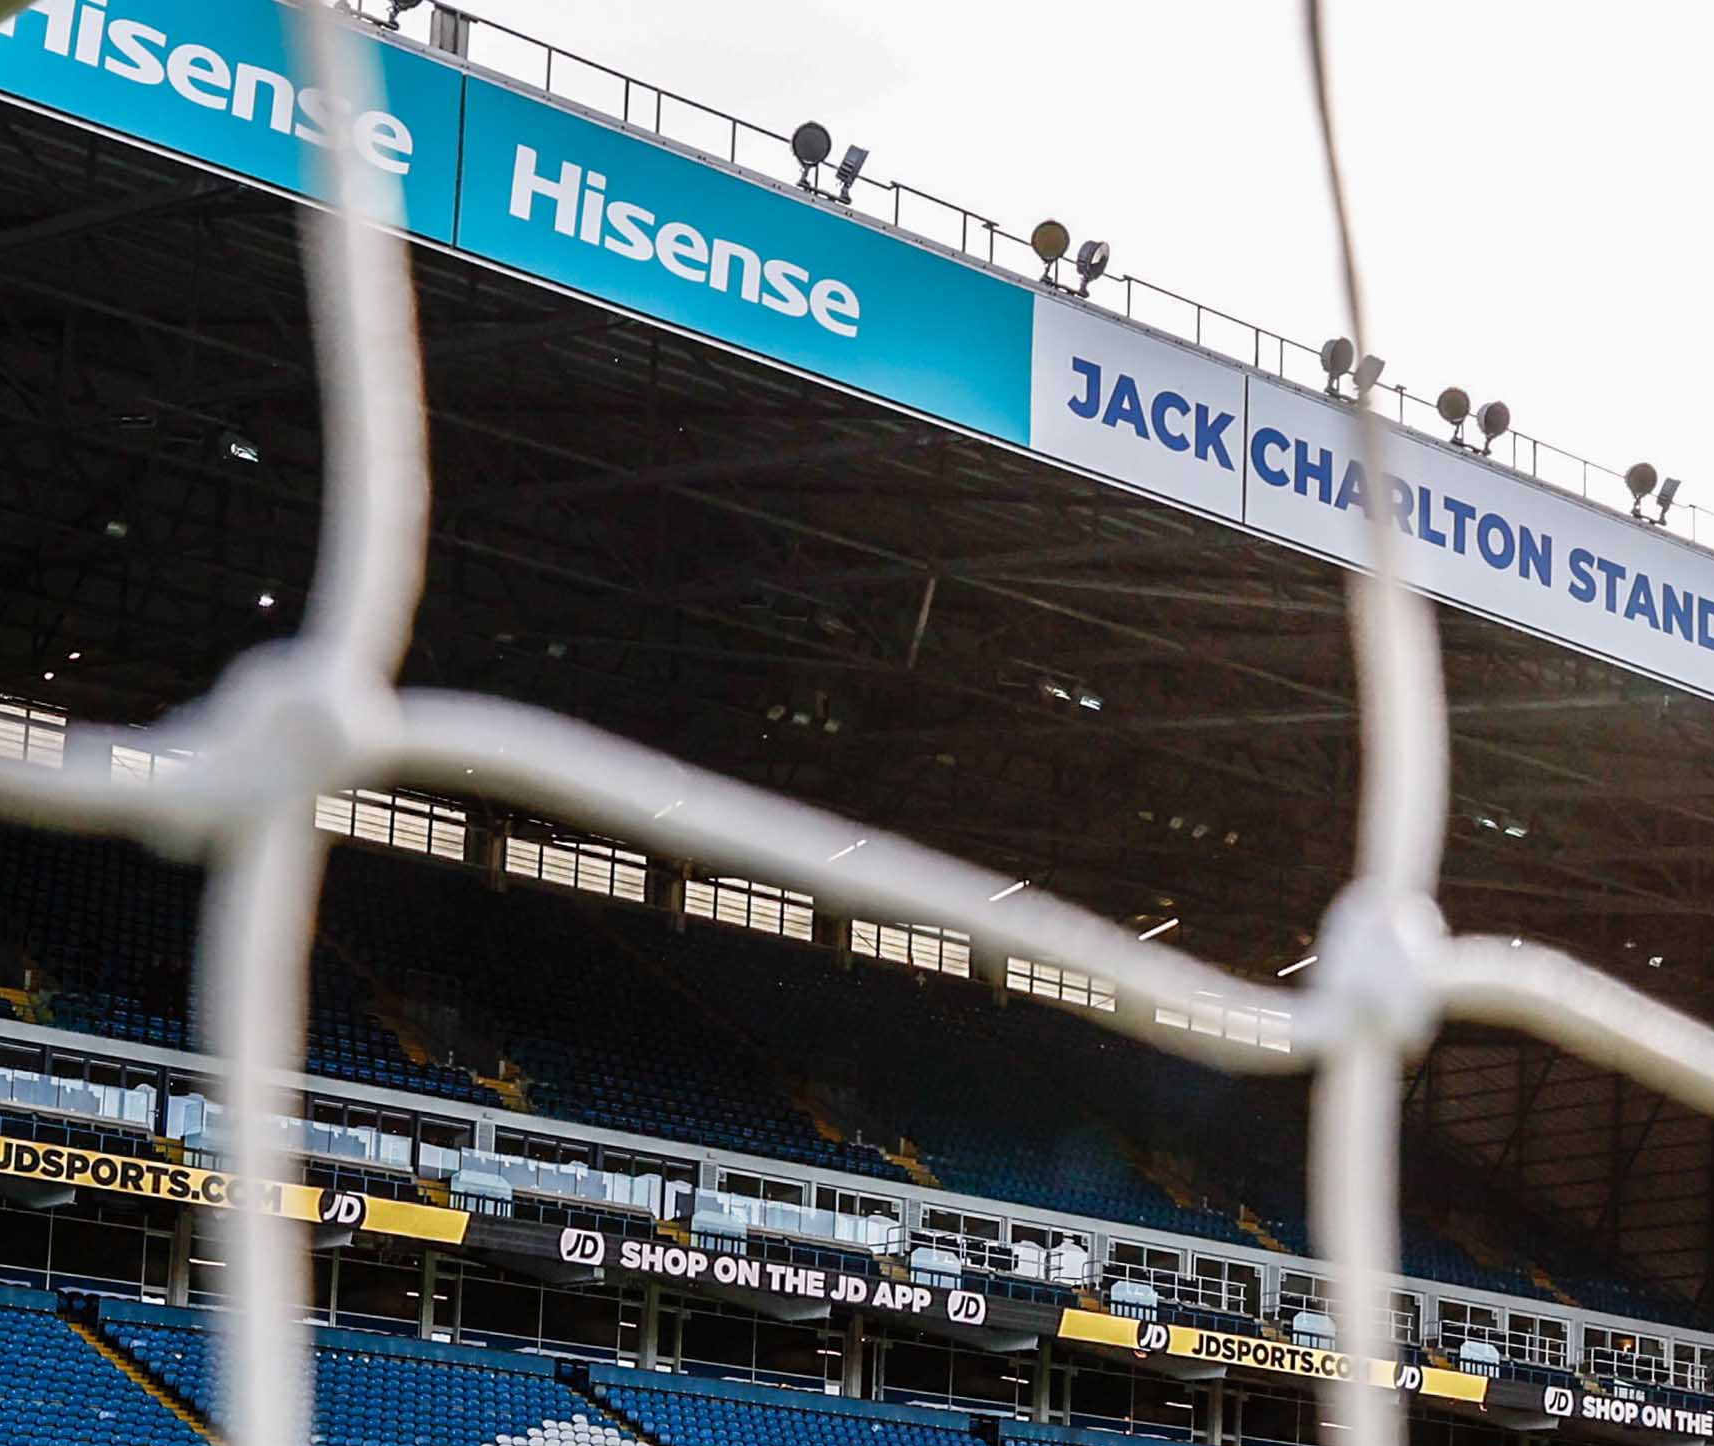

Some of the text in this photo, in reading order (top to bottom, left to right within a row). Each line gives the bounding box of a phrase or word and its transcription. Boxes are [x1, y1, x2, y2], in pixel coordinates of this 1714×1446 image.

[509, 144, 860, 338] Hisense
[1068, 357, 1235, 471] JACK
[1251, 427, 1552, 587] CHARLTON
[321, 1193, 361, 1224] JD
[565, 1232, 980, 1321] JD SHOP ON THE JD APP JD
[1140, 1325, 1420, 1389] JD JDSPORTS.CO JD
[1548, 1390, 1569, 1412] JD
[1582, 1396, 1636, 1425] SHOP
[1641, 1405, 1672, 1430] ON
[1675, 1409, 1712, 1437] THE
